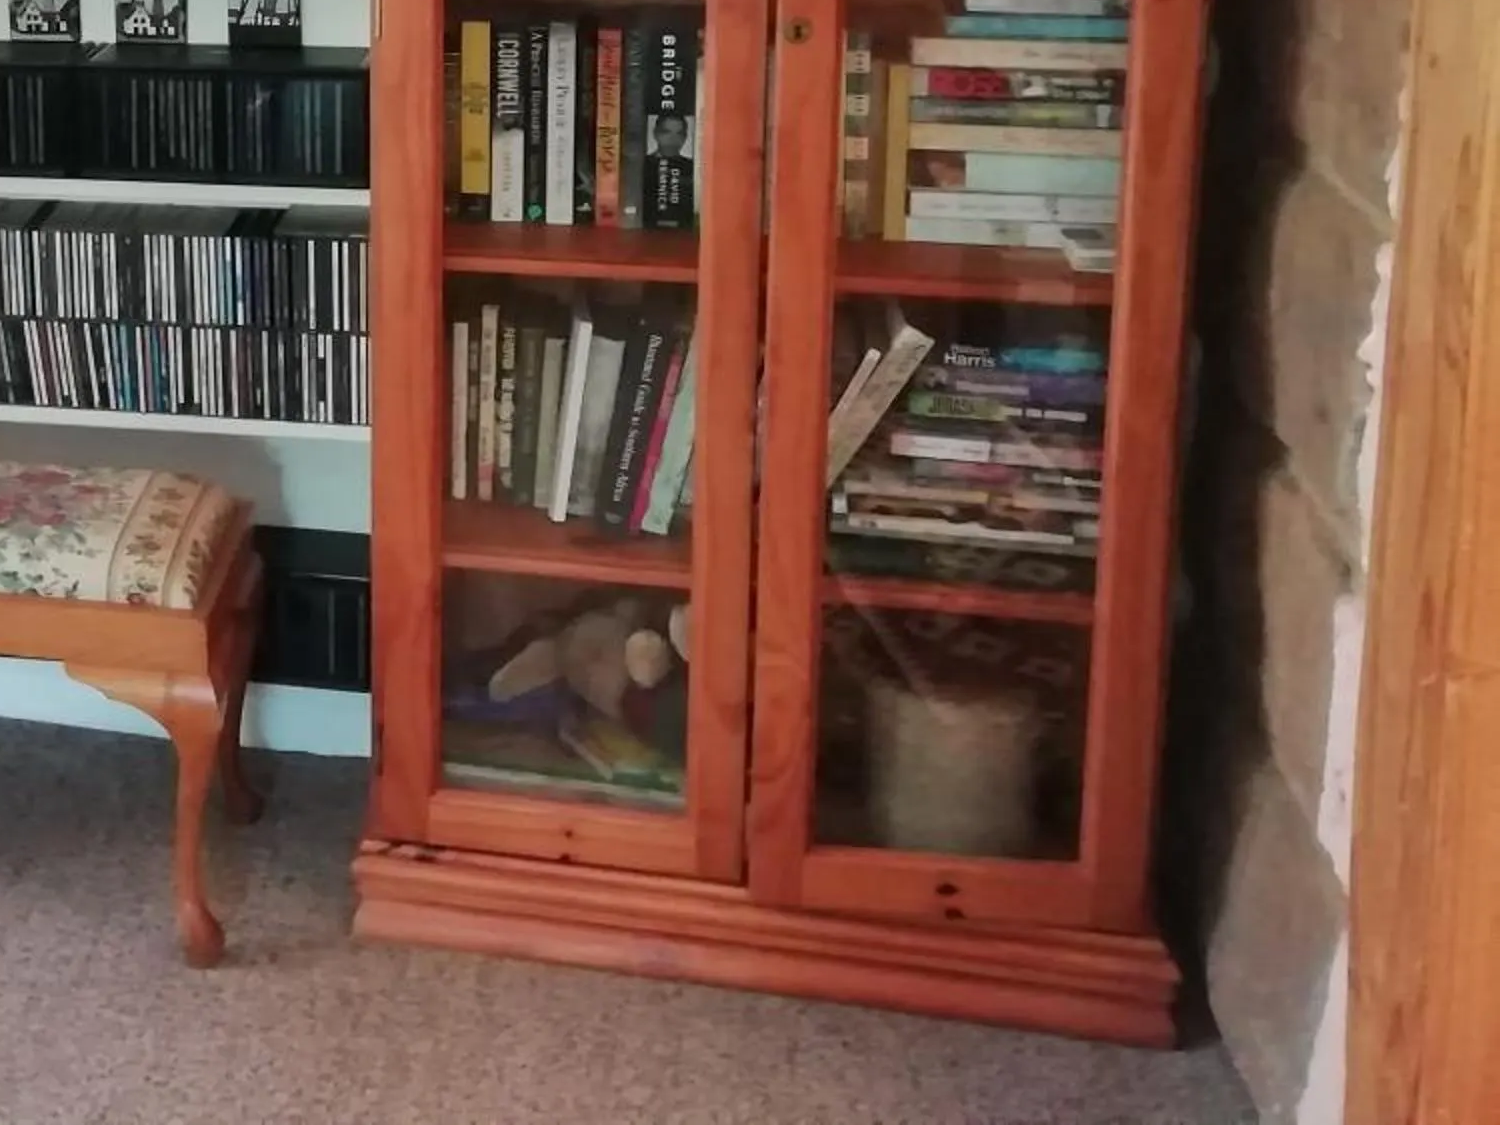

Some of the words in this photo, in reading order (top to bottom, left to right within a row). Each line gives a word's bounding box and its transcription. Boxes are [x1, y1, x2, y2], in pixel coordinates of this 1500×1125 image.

[497, 39, 521, 118] CORNWELL
[661, 34, 676, 110] BRIDGE
[670, 167, 680, 204] DAVID
[944, 352, 996, 368] Harris
